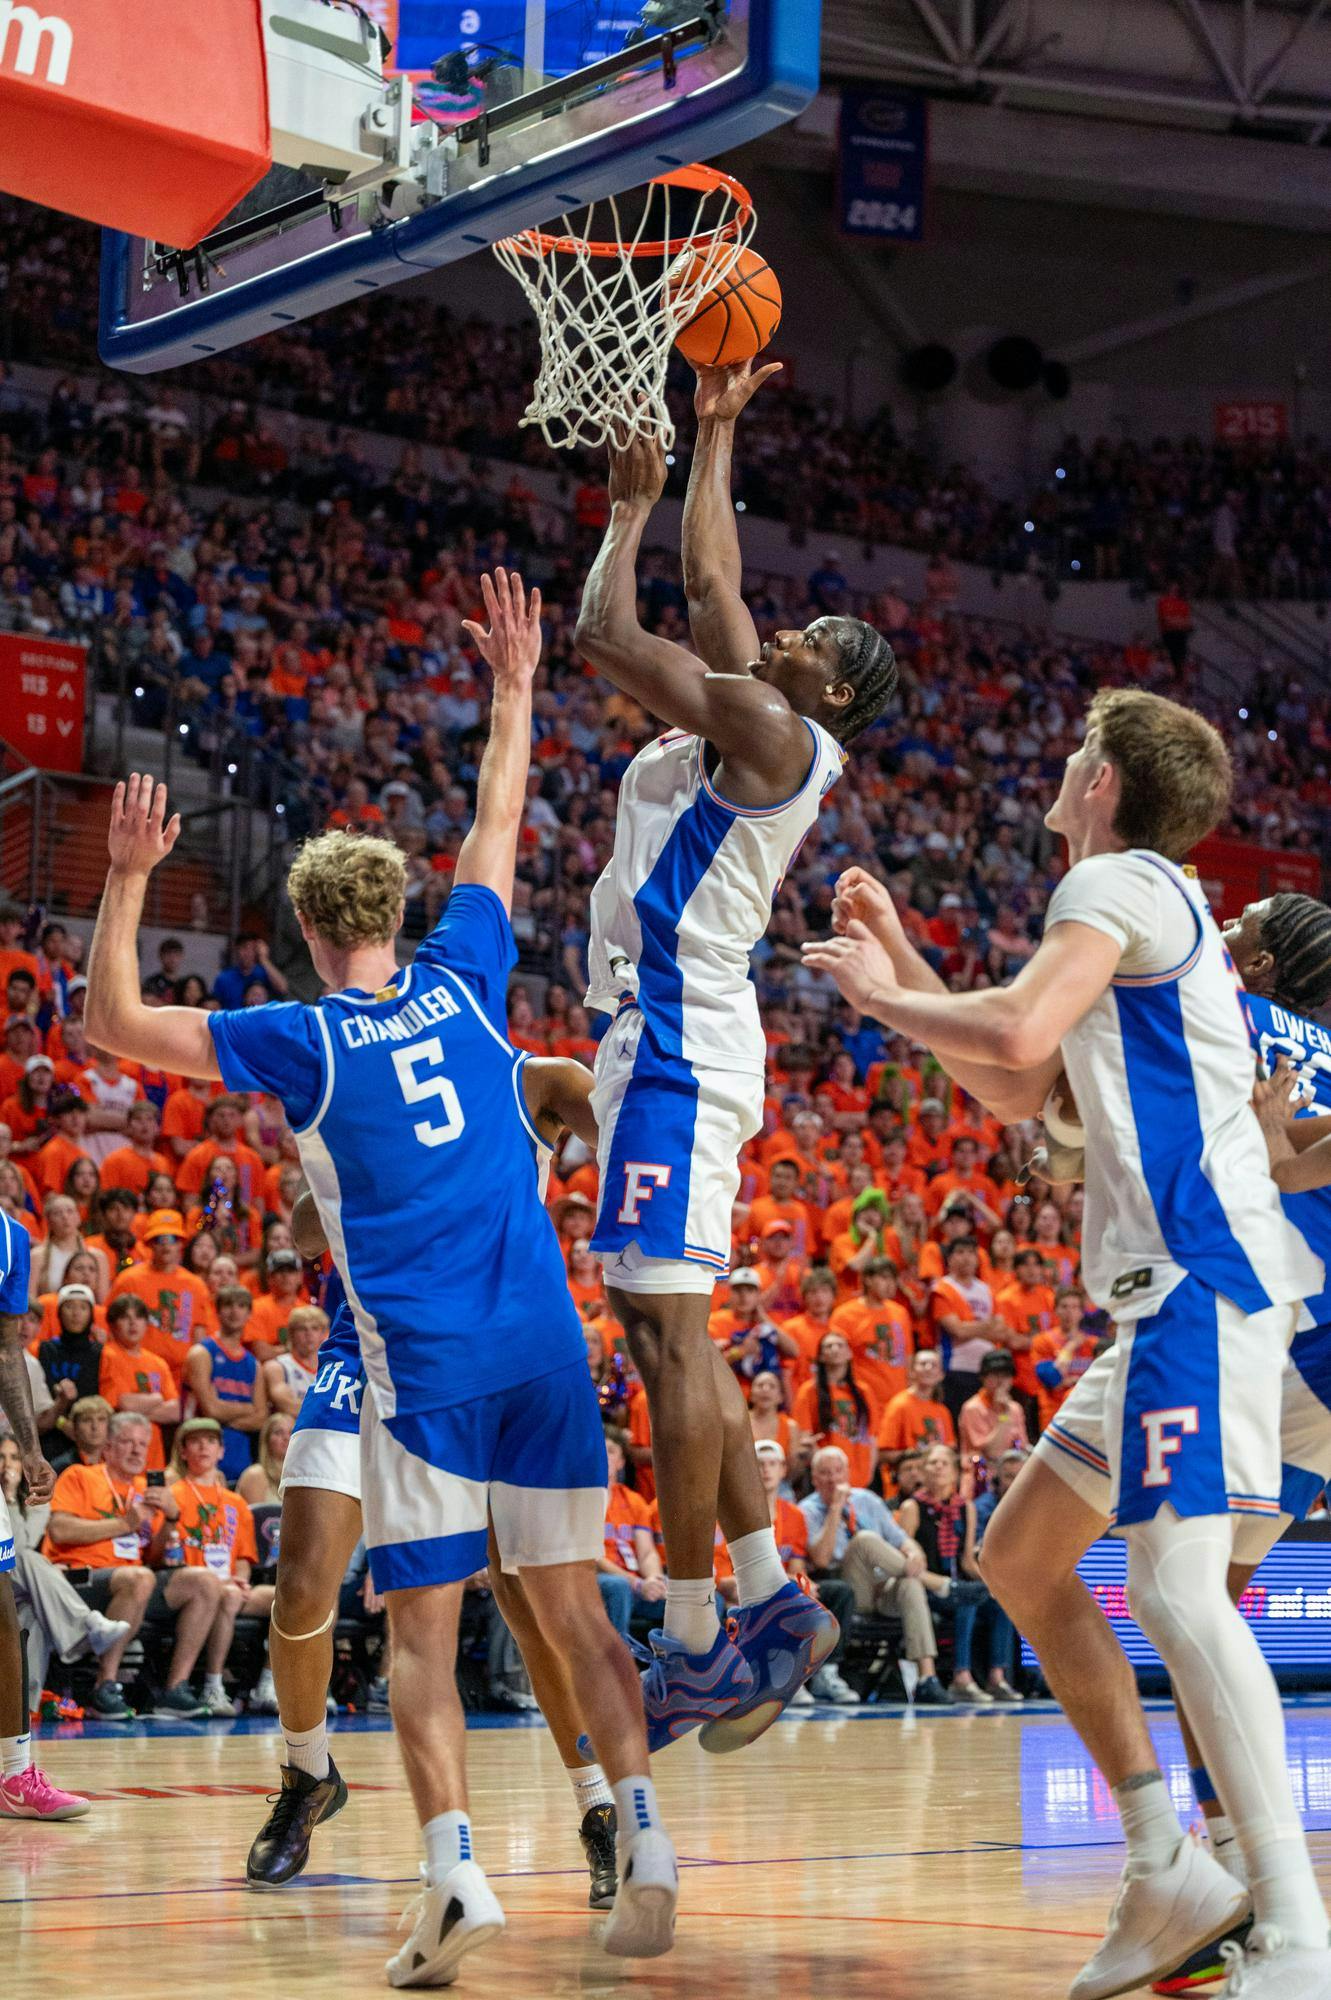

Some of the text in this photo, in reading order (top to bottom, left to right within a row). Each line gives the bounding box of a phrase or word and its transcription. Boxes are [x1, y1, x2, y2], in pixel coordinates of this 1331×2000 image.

[848, 199, 916, 231] 2024
[340, 985, 461, 1049] CHANDLER
[391, 1036, 466, 1148] 5
[617, 1161, 672, 1225] F
[314, 1361, 362, 1414] UK
[1141, 1405, 1199, 1488] F
